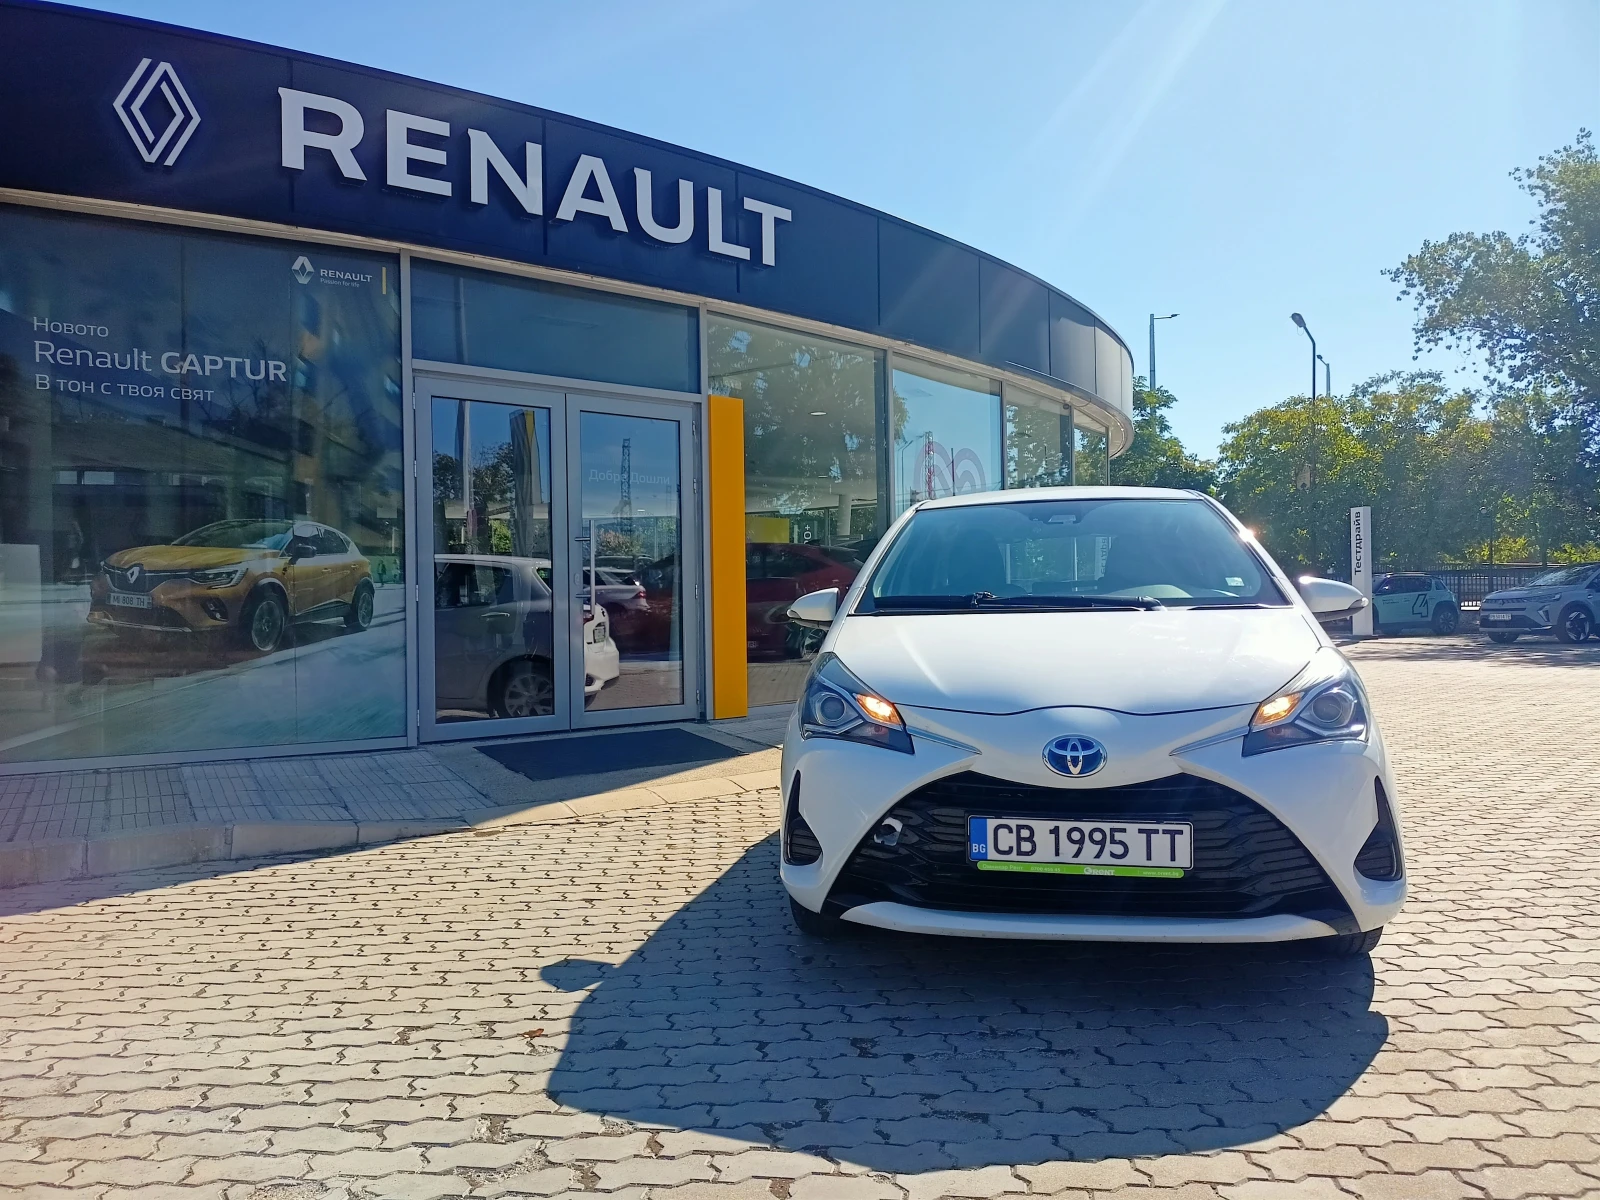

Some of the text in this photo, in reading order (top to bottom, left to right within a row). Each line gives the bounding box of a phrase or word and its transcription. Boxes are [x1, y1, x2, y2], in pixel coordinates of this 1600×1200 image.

[277, 86, 792, 267] RENAULT
[320, 268, 373, 283] RENAULT
[33, 316, 109, 338] Новото
[34, 340, 287, 382] Renault CAPTUR
[35, 373, 51, 390] В
[630, 471, 670, 485] Дошли
[1353, 511, 1363, 576] Тестдрайв
[972, 843, 986, 853] BG
[993, 824, 1184, 862] CB 1995 TT
